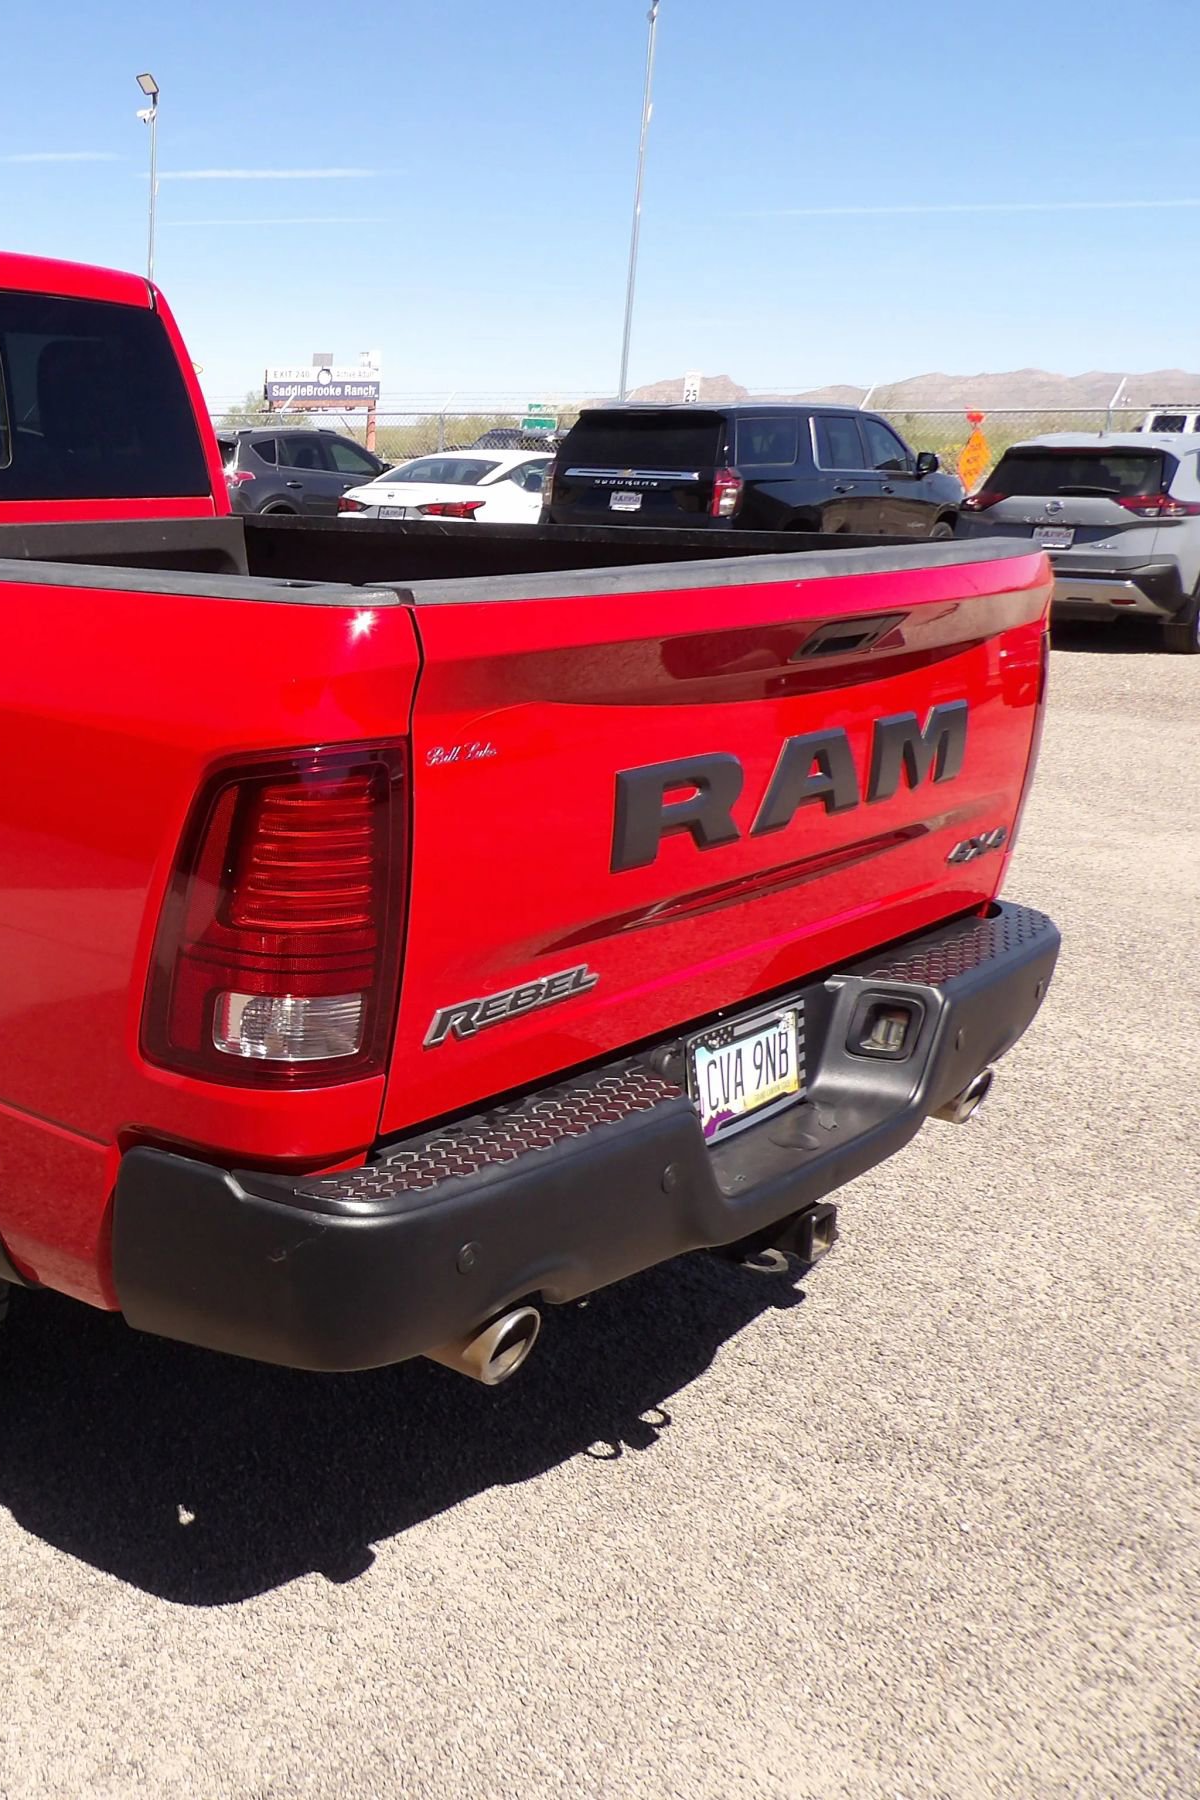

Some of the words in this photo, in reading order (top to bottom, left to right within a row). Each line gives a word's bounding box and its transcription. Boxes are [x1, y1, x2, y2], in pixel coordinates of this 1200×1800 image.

[272, 384, 342, 397] SaddleBrooke
[344, 384, 376, 397] Ranch
[273, 370, 292, 379] EXIT
[685, 389, 697, 403] 25
[609, 698, 968, 874] RAM
[422, 963, 599, 1049] REBEL
[706, 1048, 745, 1111] CVA
[753, 1032, 789, 1090] 9NB
